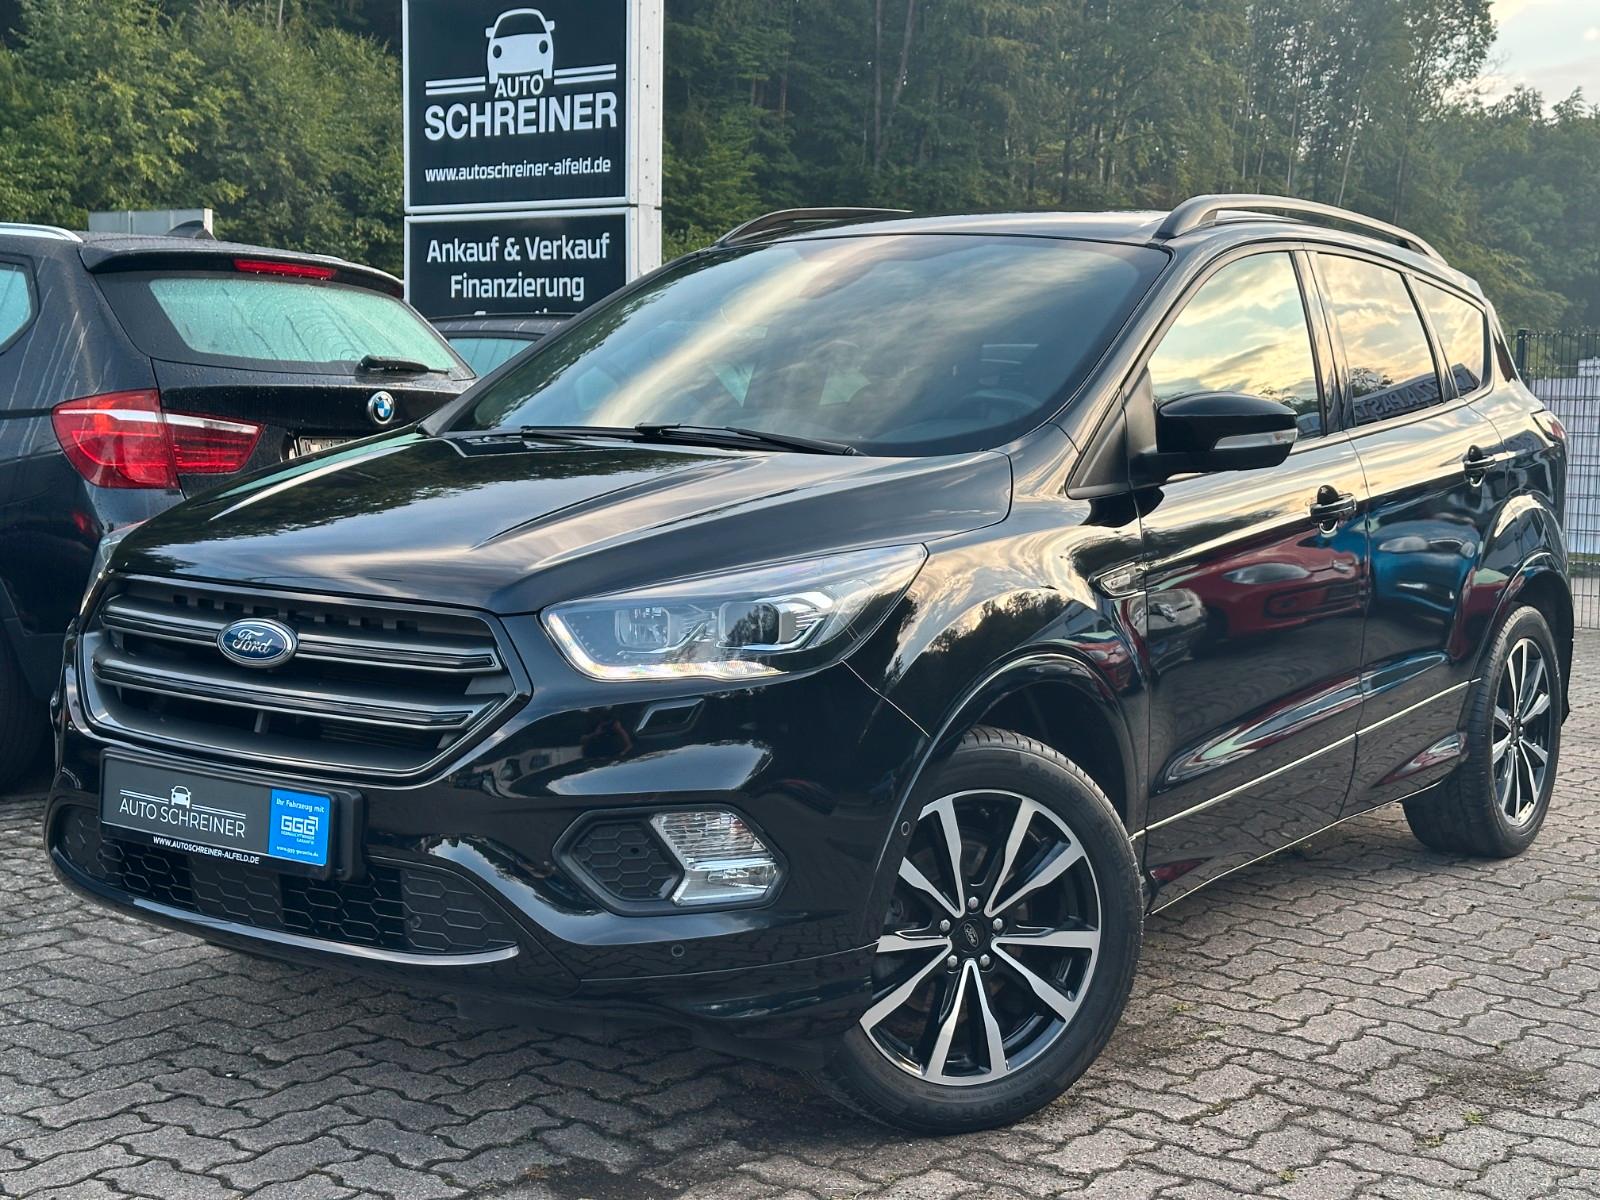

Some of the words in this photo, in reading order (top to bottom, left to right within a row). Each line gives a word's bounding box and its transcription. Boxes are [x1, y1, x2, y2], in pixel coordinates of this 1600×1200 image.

[494, 74, 544, 98] AUTO
[424, 92, 617, 141] SCHREINER
[425, 156, 611, 182] www.autoschreiner-alfeld.de
[426, 237, 499, 263] Ankauf
[504, 237, 520, 261] &
[525, 232, 610, 261] Verkauf
[450, 272, 584, 301] Finanzierung
[232, 628, 273, 654] Ford
[119, 798, 157, 820] AUTO
[160, 807, 246, 838] SCHREINER
[276, 798, 285, 806] Ihr
[286, 799, 313, 813] Fahrzeug
[313, 805, 325, 813] mit
[281, 815, 316, 836] GGG
[153, 836, 260, 865] WWW.AUTOSCHREINER-ALFELD.DE
